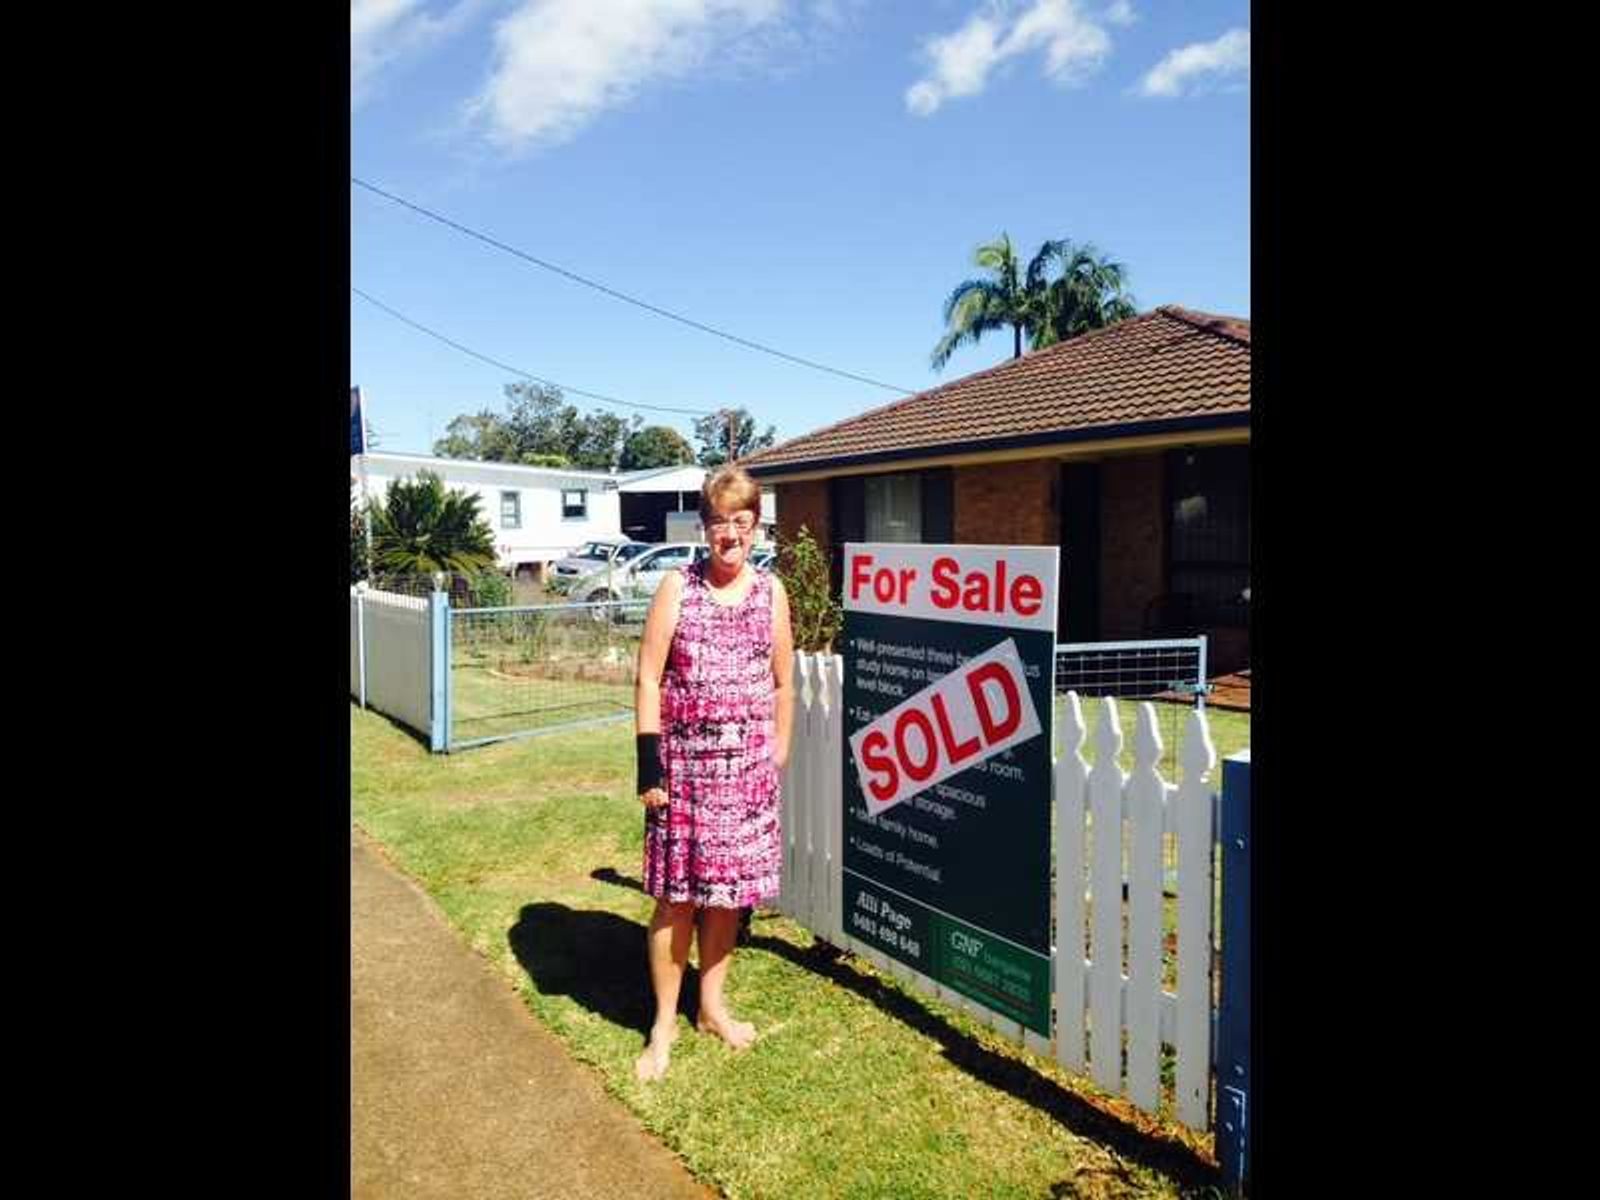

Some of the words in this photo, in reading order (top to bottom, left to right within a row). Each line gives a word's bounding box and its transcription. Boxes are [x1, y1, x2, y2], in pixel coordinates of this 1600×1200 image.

[851, 555, 917, 605] For
[930, 557, 1043, 616] Sale
[862, 661, 1022, 801] SOLD
[880, 901, 912, 929] Page
